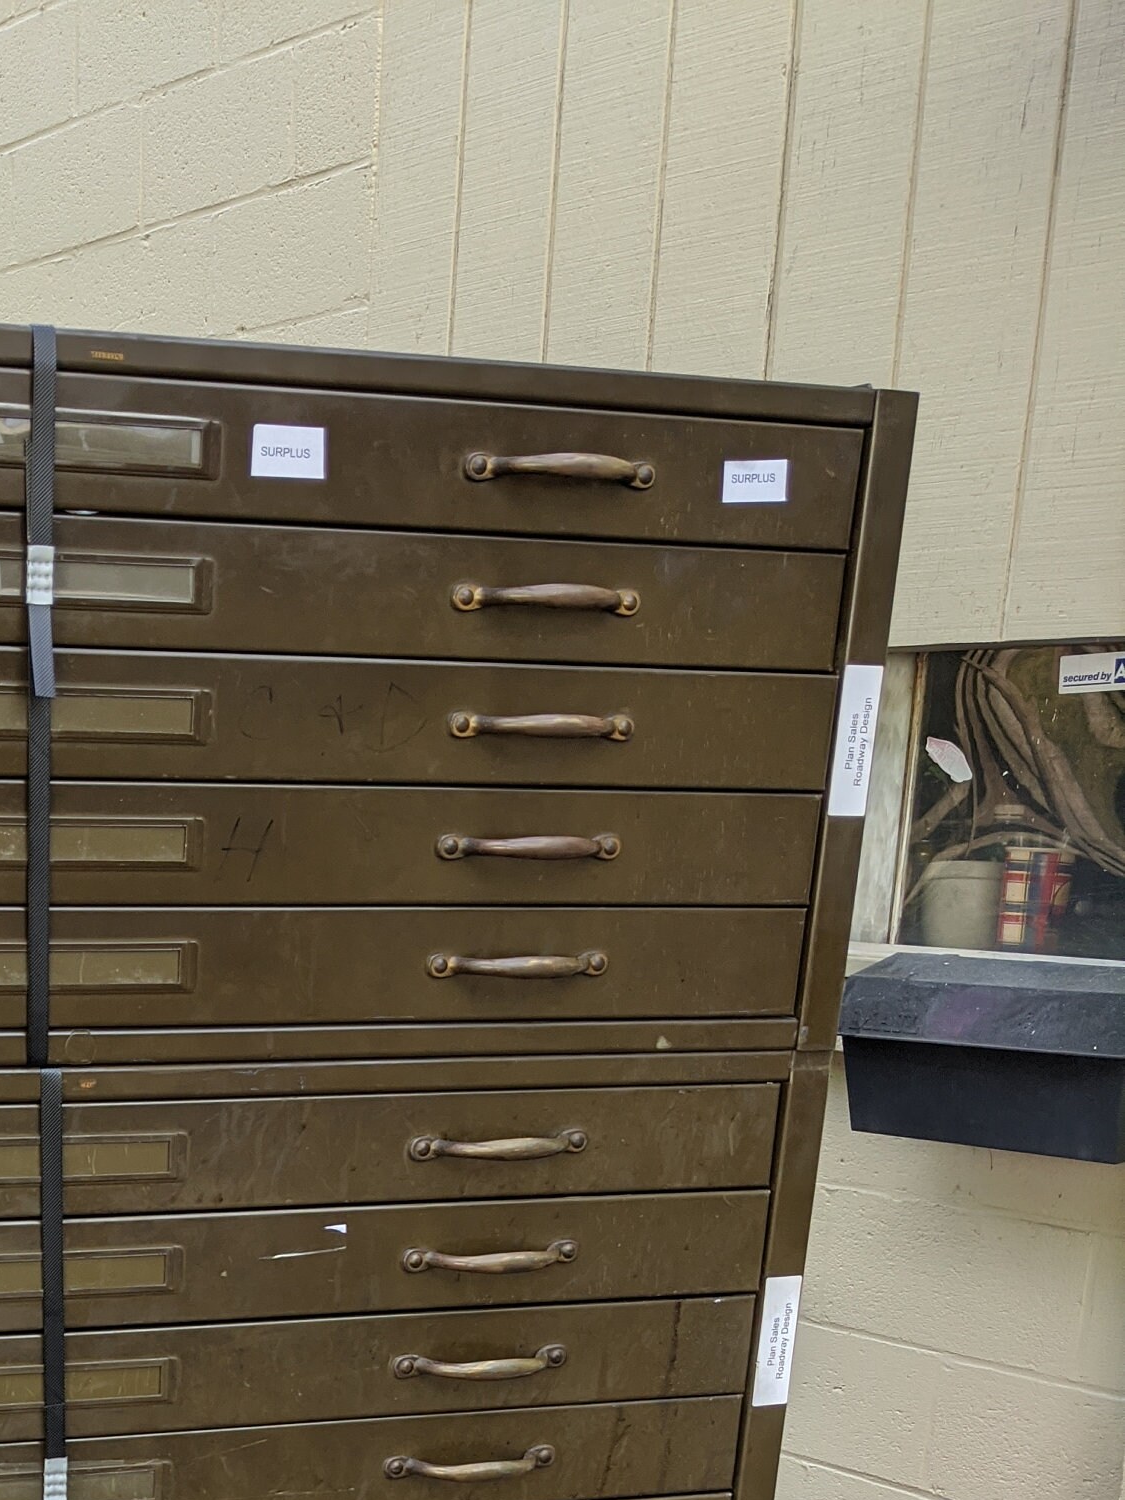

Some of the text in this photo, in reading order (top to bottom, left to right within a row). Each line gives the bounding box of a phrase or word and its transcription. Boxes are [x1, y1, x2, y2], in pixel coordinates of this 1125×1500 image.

[260, 445, 311, 460] SURPLUS
[731, 472, 777, 485] SURPLUS
[1063, 672, 1112, 682] secured by
[844, 713, 859, 770] Plan Sales
[853, 698, 872, 787] Roadway Design
[767, 1318, 780, 1366] Plan Sales
[776, 1302, 793, 1379] Roadway Design
